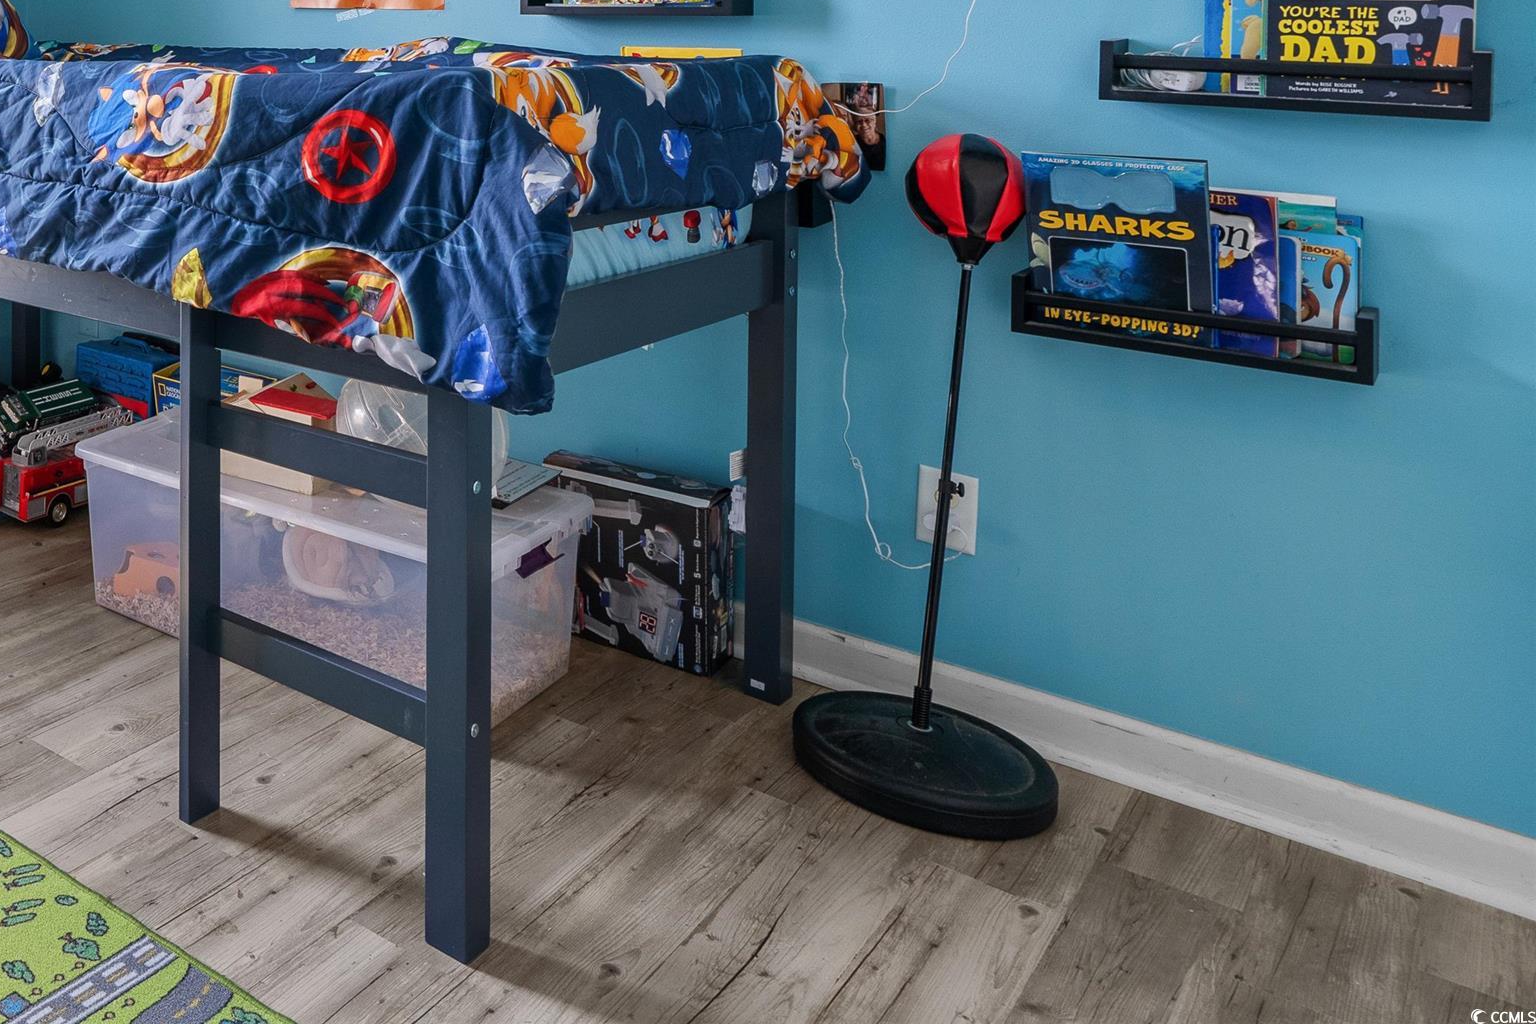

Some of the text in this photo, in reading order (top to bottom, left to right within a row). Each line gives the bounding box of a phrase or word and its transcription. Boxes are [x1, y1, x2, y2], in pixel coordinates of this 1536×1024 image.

[1279, 6, 1379, 19] YOU'RE THE
[1393, 15, 1412, 23] DAD
[1278, 19, 1379, 35] COOLEST
[1280, 35, 1376, 65] DAD
[1039, 210, 1195, 241] SHARKS
[1044, 307, 1201, 339] IN EYE-POPPING 3D!
